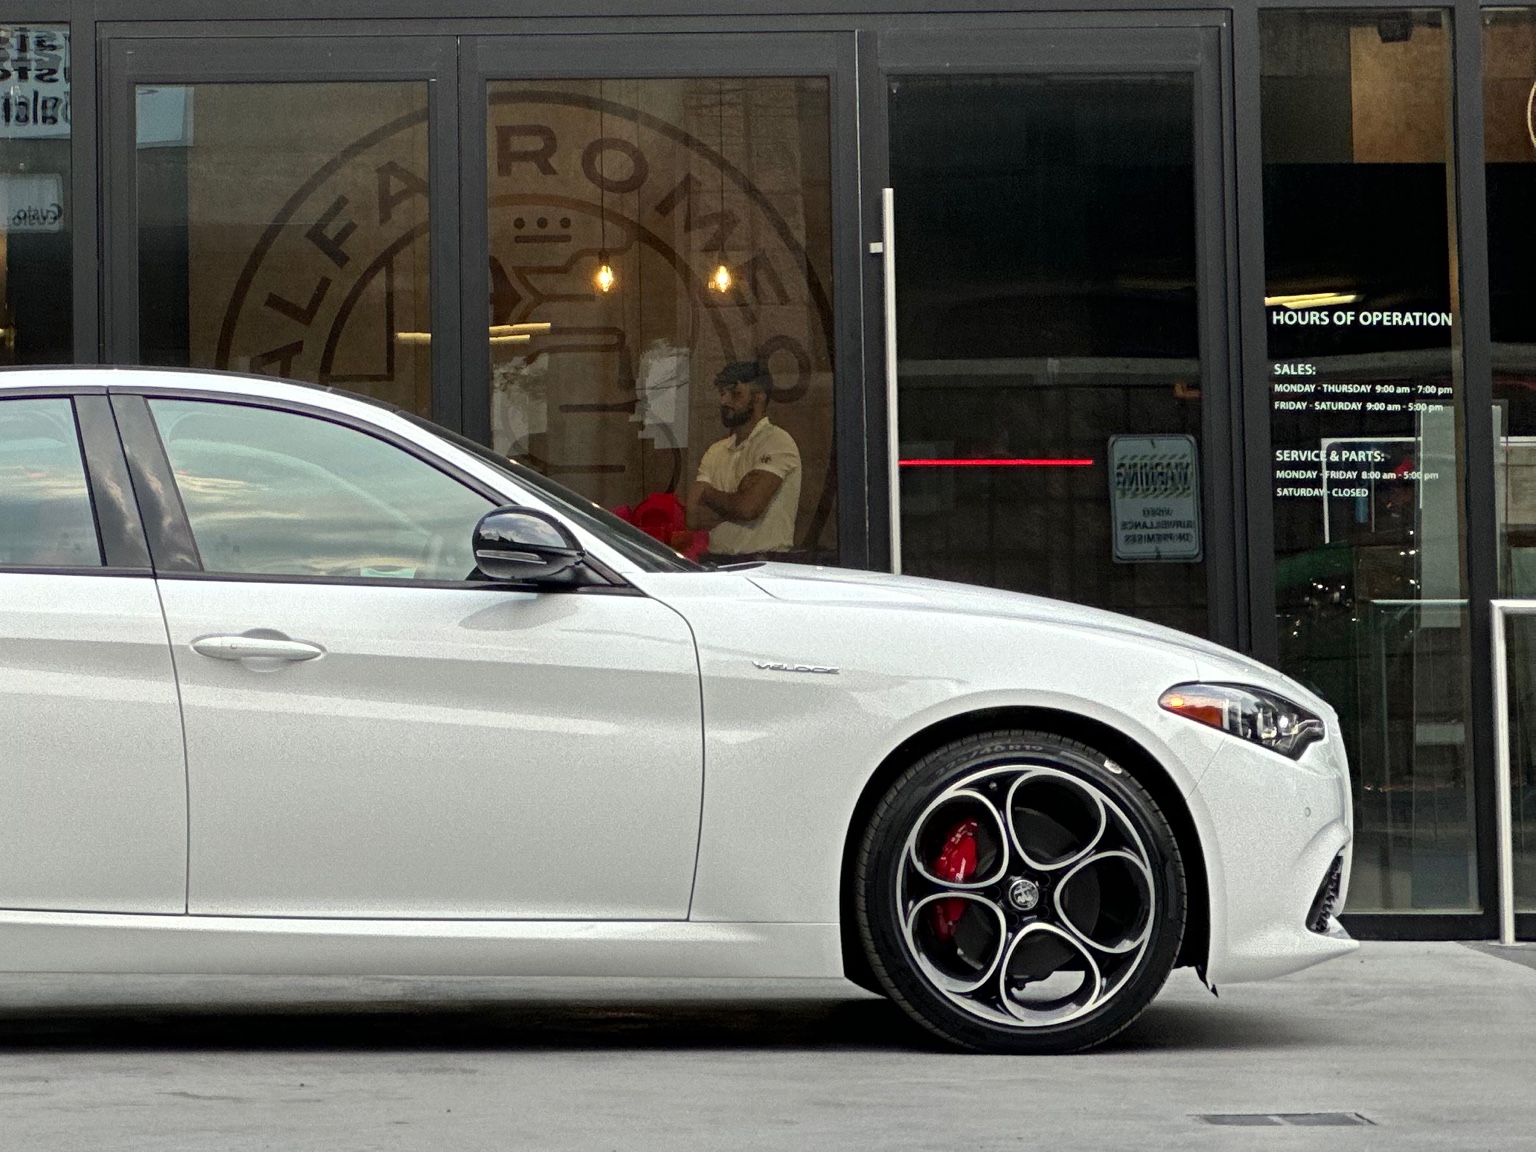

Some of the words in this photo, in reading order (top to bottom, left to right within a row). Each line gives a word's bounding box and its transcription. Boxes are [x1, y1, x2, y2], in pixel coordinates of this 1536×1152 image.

[494, 122, 813, 406] ROMEO
[1272, 311, 1329, 325] HOURS
[1333, 311, 1355, 325] OF
[1359, 311, 1452, 326] OPERATION
[1274, 364, 1316, 375] SALES:
[1274, 384, 1315, 393] MONDAY
[1322, 384, 1371, 393] THURSDAY
[1375, 385, 1395, 393] 9:00
[1417, 385, 1437, 394] 7:00
[1438, 387, 1452, 396] pm
[1274, 401, 1307, 410] FRIDAY
[1314, 402, 1362, 411] SATURDAY
[1366, 403, 1385, 411] 9:00
[1428, 404, 1443, 413] pm
[1276, 450, 1326, 462] SERVICE
[1330, 451, 1339, 462] &
[1342, 451, 1385, 462] PARTS:
[1276, 471, 1317, 479] MONDAY
[1325, 471, 1358, 479] FRIDAY
[1276, 488, 1325, 497] SATURDAY
[1332, 488, 1369, 497] CLOSED
